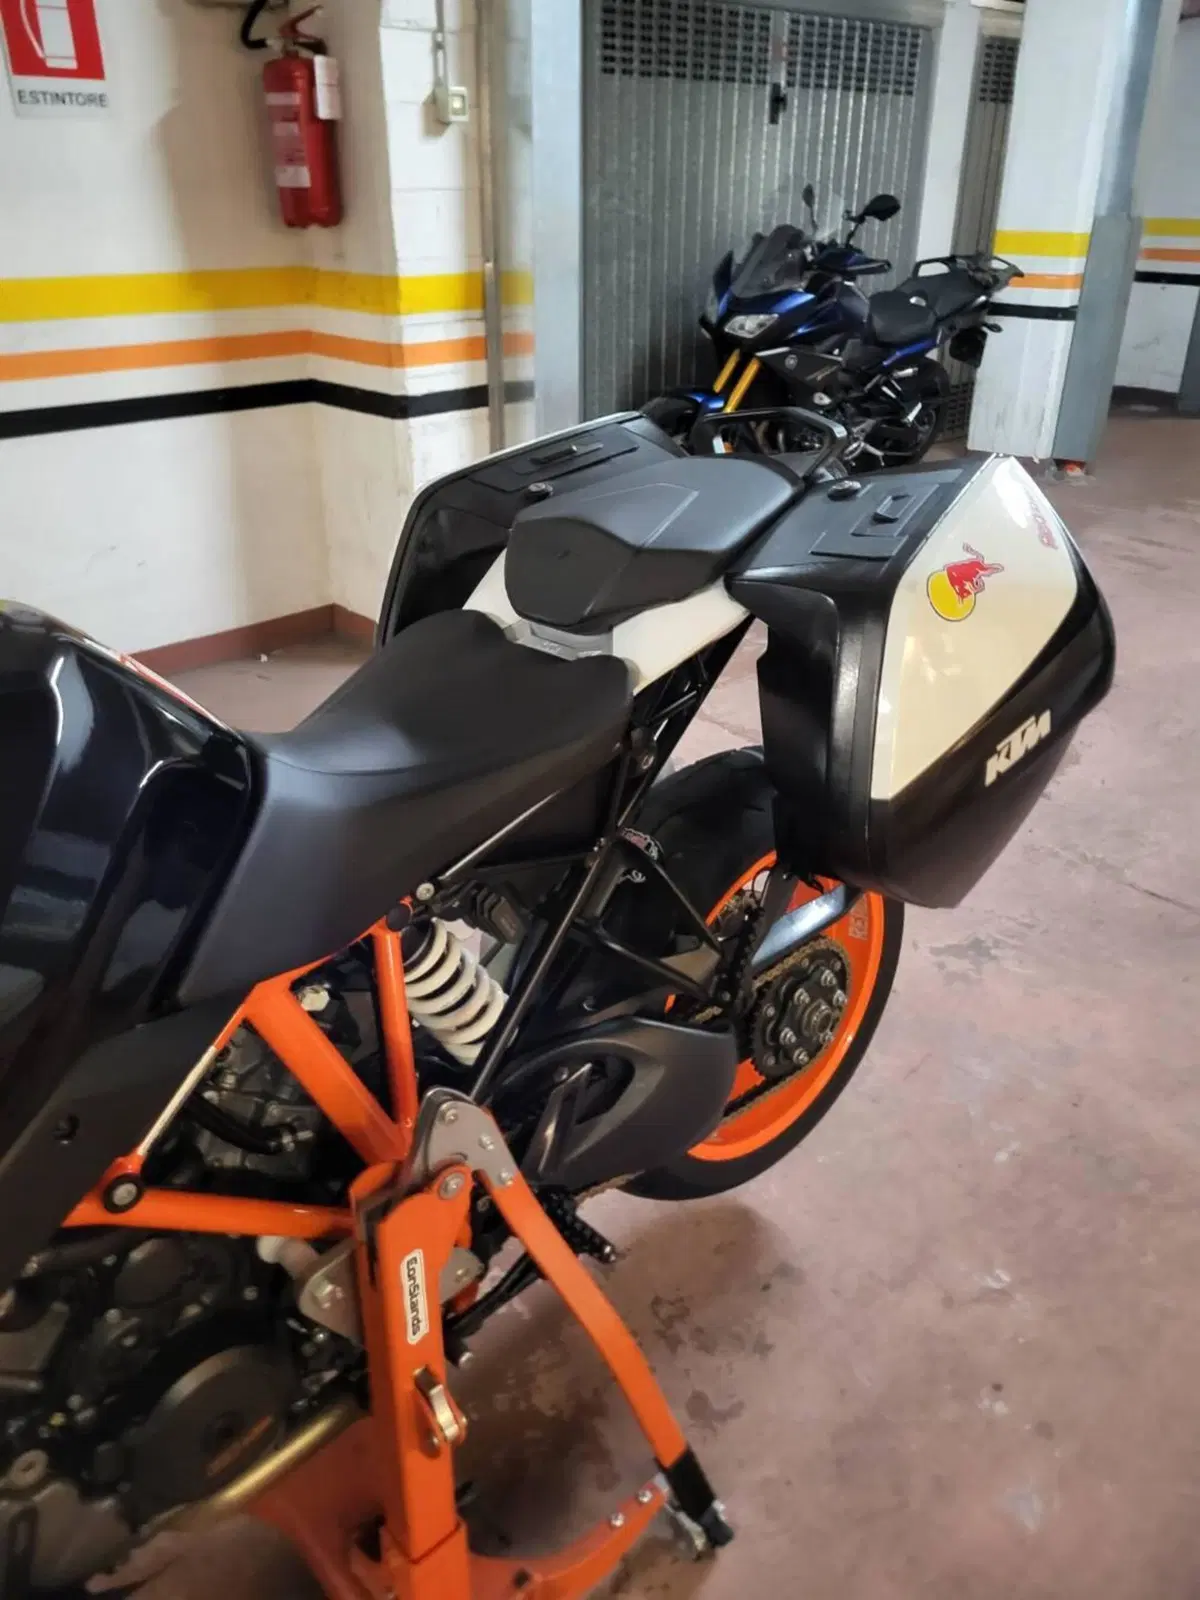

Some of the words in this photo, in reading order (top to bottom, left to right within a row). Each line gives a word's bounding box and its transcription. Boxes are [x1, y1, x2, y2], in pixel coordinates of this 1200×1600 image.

[17, 88, 108, 108] ESTINTORE
[984, 708, 1052, 788] KTM
[406, 1256, 421, 1337] EonStands
